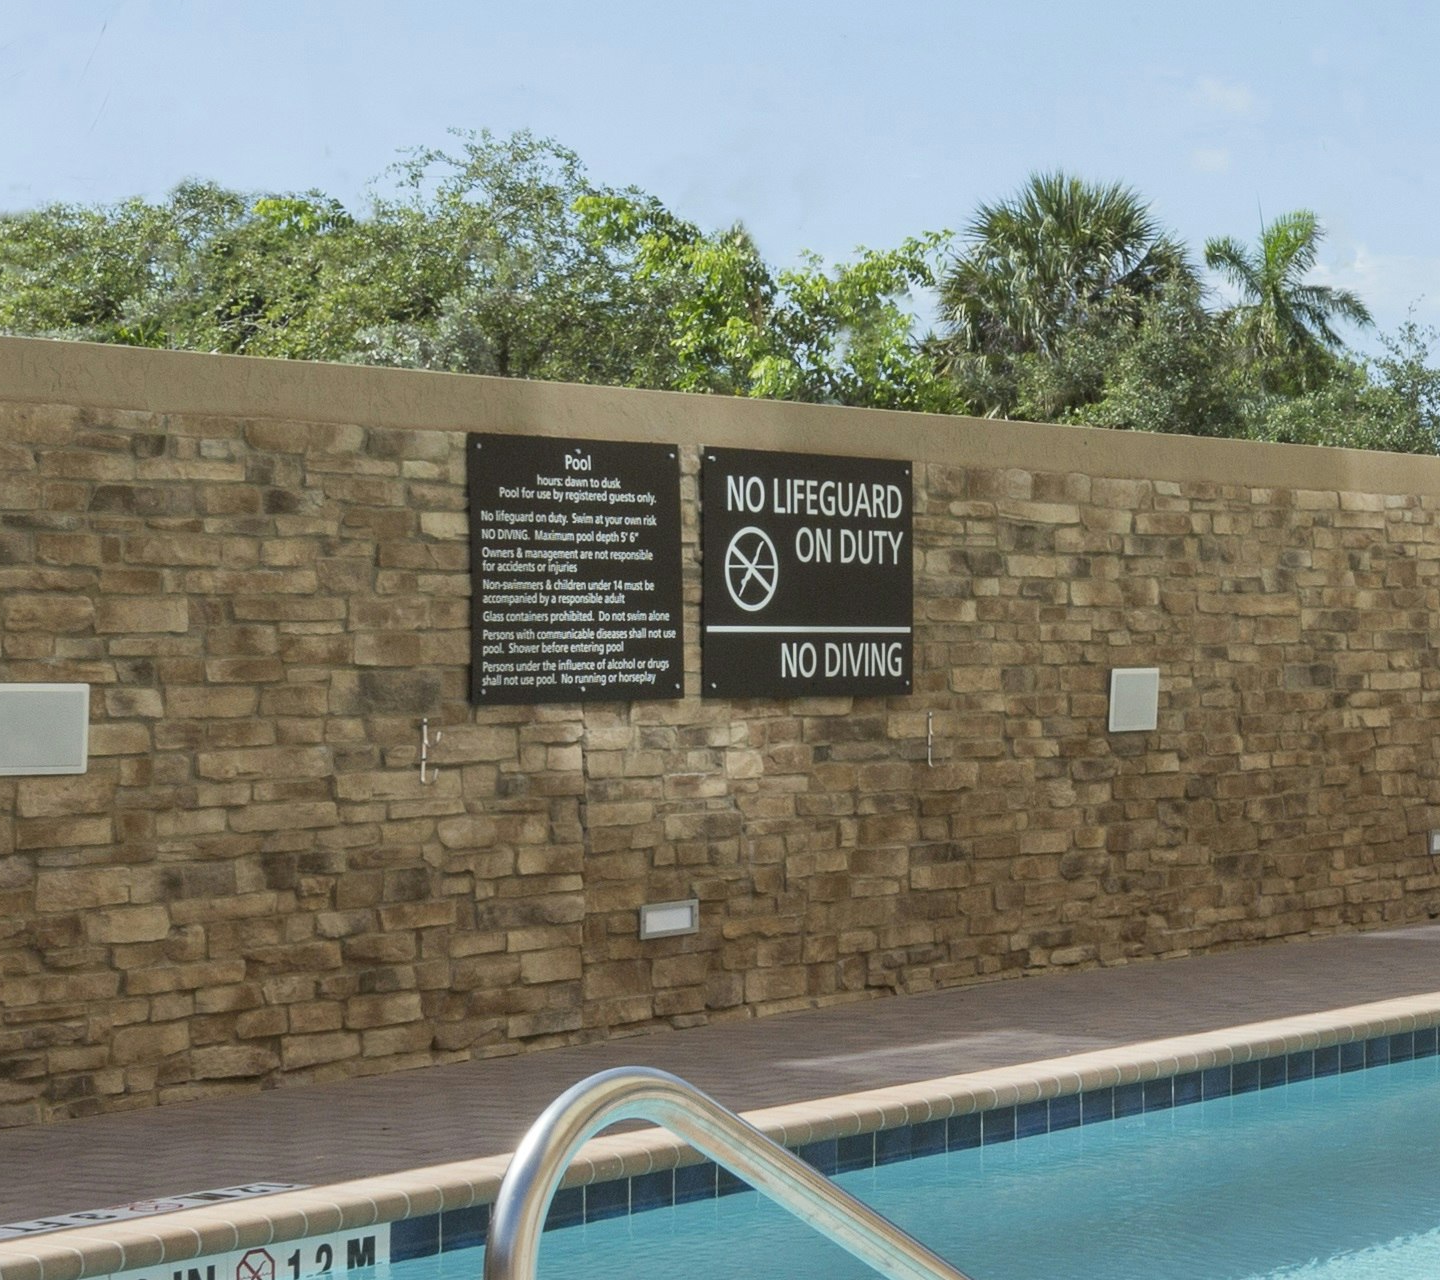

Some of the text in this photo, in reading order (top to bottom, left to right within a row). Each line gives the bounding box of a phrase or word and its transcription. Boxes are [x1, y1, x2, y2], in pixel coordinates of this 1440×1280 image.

[564, 455, 591, 471] Pool
[564, 475, 588, 487] dawn
[589, 478, 599, 488] to
[600, 477, 621, 489] dusk
[499, 486, 519, 498] Pool
[521, 486, 534, 498] for
[536, 490, 551, 499] use
[552, 488, 564, 502] by
[565, 488, 607, 504] registered
[608, 492, 635, 505] guests
[727, 475, 902, 518] NO LIFEGUARD
[480, 510, 493, 521] No
[495, 509, 533, 525] lifeguard
[535, 513, 546, 522] on
[571, 512, 593, 524] Swim
[594, 514, 603, 524] at
[604, 516, 623, 527] your
[624, 516, 641, 525] own
[643, 514, 656, 526] risk
[481, 528, 495, 539] NO
[534, 529, 574, 541] Maximum
[576, 530, 594, 544] pool
[595, 530, 619, 544] depth
[481, 546, 653, 562] Owners & management are not responsible
[795, 527, 904, 565] ON DUTY
[482, 559, 577, 575] for accidents or injuries
[482, 578, 654, 590] Non-swimmers & children under 14 must be
[482, 592, 625, 606] accompanied by a responsible adult
[482, 610, 504, 621] Glass
[505, 610, 548, 621] containers
[598, 610, 610, 621] Do
[611, 611, 625, 621] not
[626, 610, 647, 621] swim
[648, 610, 669, 621] alone
[482, 627, 676, 640] Persons with communicable diseases shall not use
[508, 642, 540, 653] Shower
[541, 641, 569, 653] before
[570, 641, 604, 655] entering
[605, 640, 624, 654] pool
[482, 657, 669, 672] Persons under the influence of alcohol or drugs
[781, 642, 902, 678] NO DIVING
[482, 674, 501, 686] shall
[503, 675, 518, 685] not
[520, 676, 534, 685] use
[561, 673, 573, 684] No
[574, 672, 606, 686] running
[607, 674, 617, 682] or
[618, 670, 656, 685] horseplay
